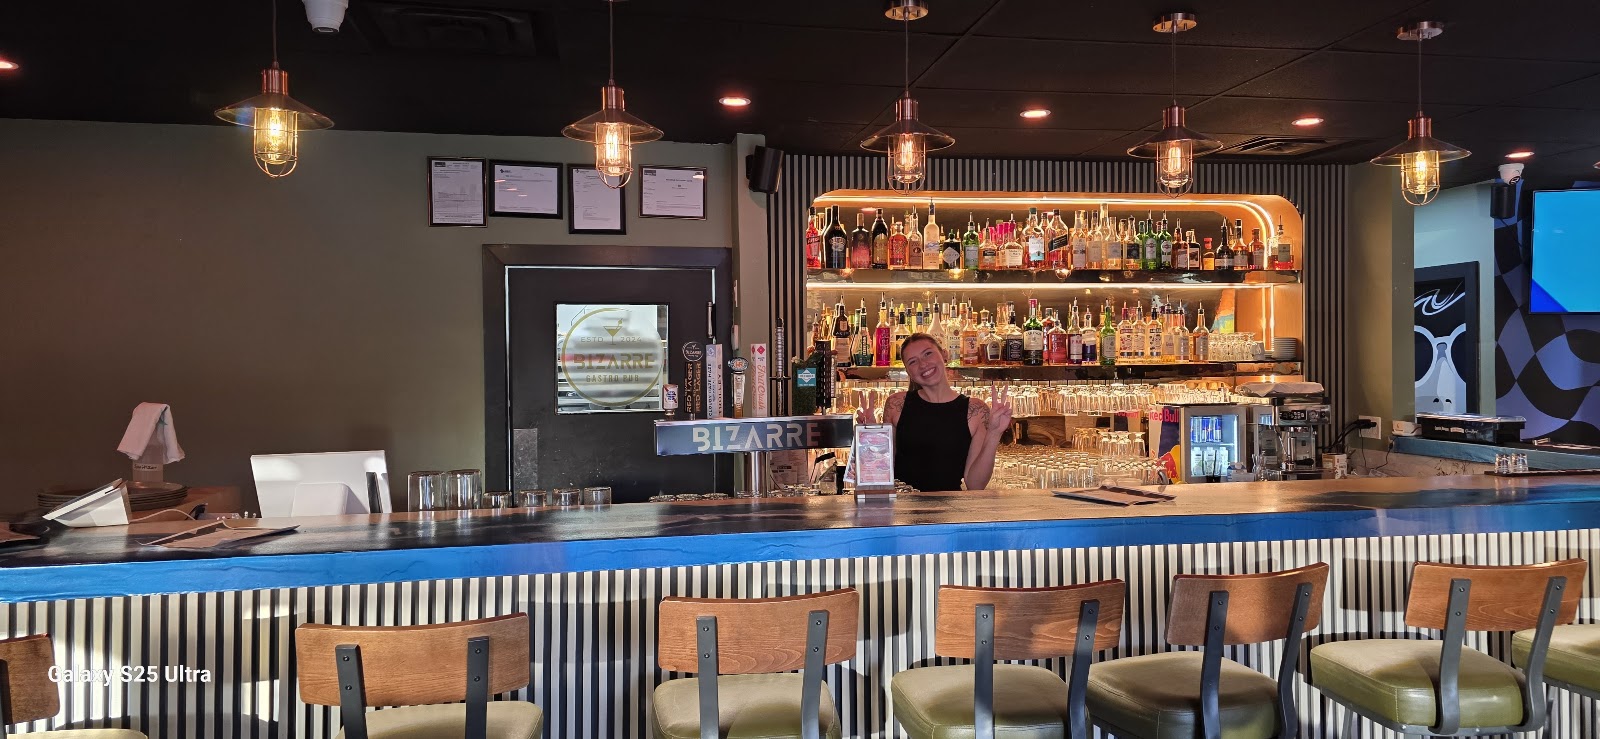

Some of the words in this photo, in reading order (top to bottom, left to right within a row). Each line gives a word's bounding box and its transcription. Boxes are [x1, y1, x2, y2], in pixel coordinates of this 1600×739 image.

[573, 352, 656, 370] BIZARRE
[586, 374, 619, 382] GASTRO
[622, 374, 640, 382] PUB
[757, 385, 766, 411] Crush
[1164, 408, 1179, 422] Bull
[692, 422, 821, 452] BIZARRE
